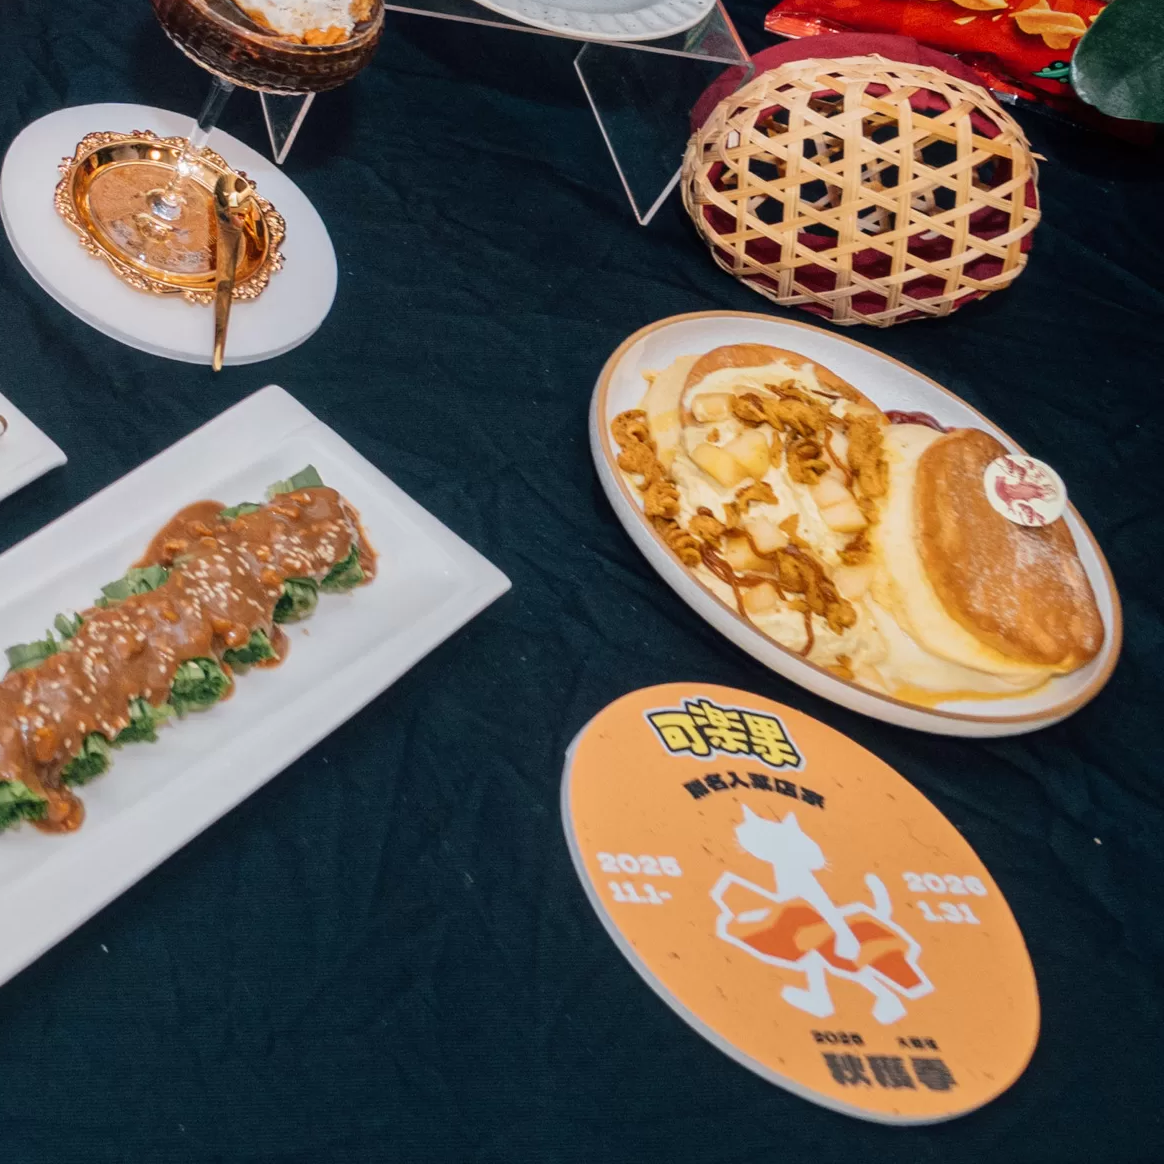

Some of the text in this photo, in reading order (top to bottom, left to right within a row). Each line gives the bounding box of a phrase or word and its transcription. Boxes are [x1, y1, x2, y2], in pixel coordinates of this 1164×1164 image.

[596, 851, 683, 878] 2025
[901, 871, 989, 898] 2026
[916, 900, 981, 925] 1.31
